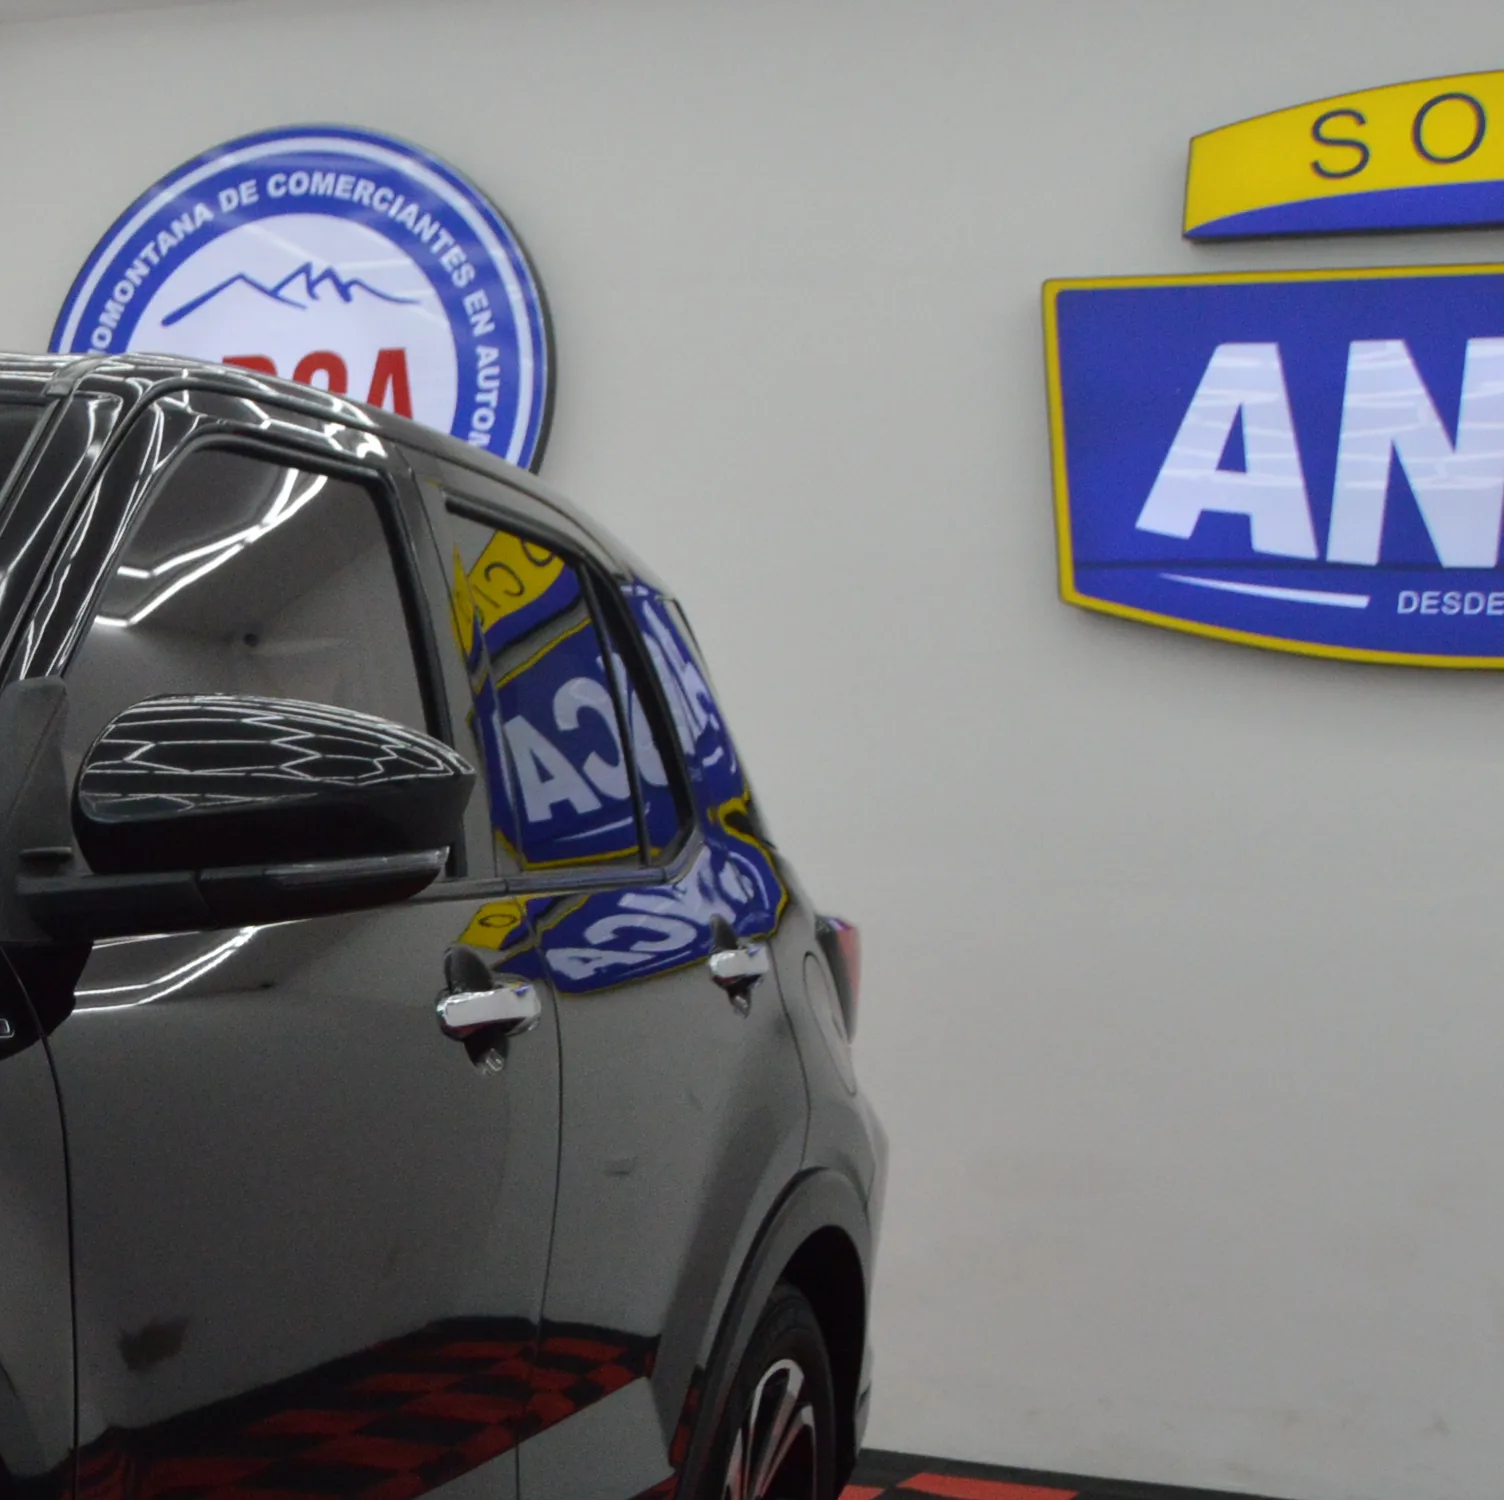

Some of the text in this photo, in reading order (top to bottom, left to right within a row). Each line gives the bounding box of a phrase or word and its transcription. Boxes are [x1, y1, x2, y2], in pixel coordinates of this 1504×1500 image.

[88, 203, 215, 355] OMONTANA
[218, 179, 259, 213] DE
[266, 171, 476, 288] COMERCIANTES
[463, 289, 496, 337] EN
[1396, 590, 1504, 616] DESDE
